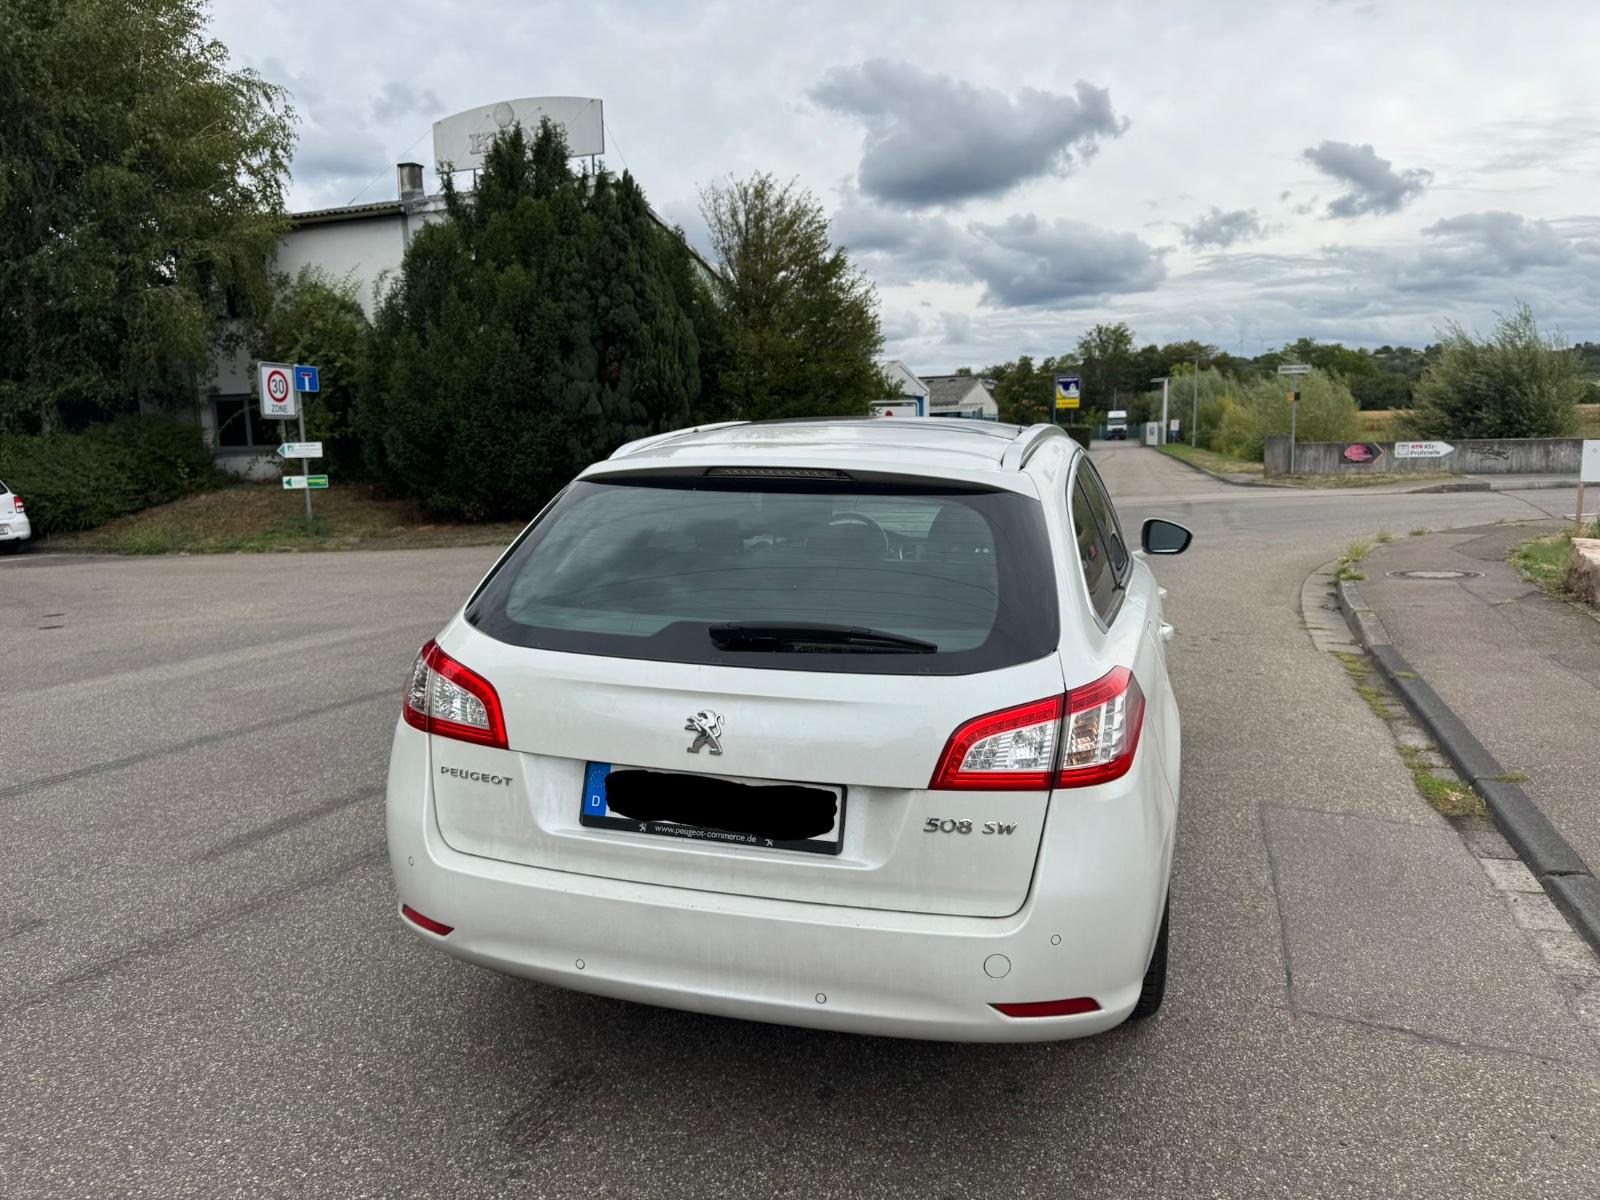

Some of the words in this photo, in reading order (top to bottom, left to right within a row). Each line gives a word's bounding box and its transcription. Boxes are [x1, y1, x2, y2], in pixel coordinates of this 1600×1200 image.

[271, 379, 285, 394] 30
[271, 404, 288, 413] ZONE
[440, 765, 513, 787] PEUGEOT
[591, 795, 601, 807] D
[654, 824, 757, 843] www.peugeot-commerce.de
[923, 817, 973, 835] 508
[981, 821, 1018, 835] SW
